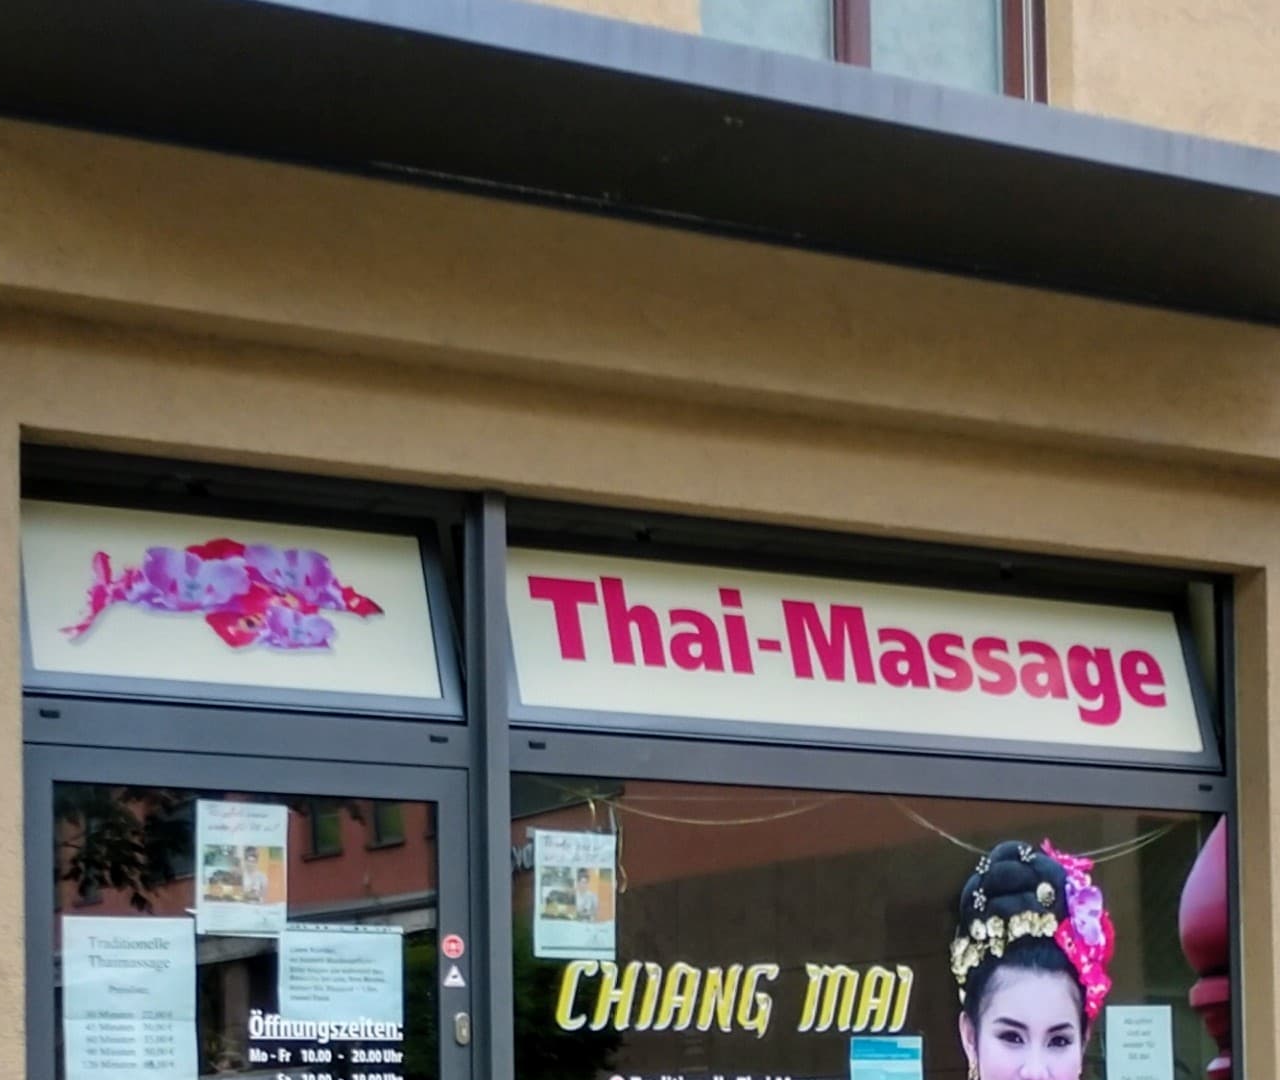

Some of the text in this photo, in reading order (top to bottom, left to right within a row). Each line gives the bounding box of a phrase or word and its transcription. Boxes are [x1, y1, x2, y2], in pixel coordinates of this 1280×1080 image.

[528, 575, 1168, 727] Thai-Massage
[248, 1009, 404, 1044] Öffnungszeiten:
[554, 960, 914, 1039] CHIANG MAI
[249, 1048, 268, 1062] Mo
[278, 1048, 292, 1062] Fr
[300, 1049, 332, 1063] 10.00
[351, 1049, 382, 1063] 20.00
[383, 1049, 403, 1063] Uhr
